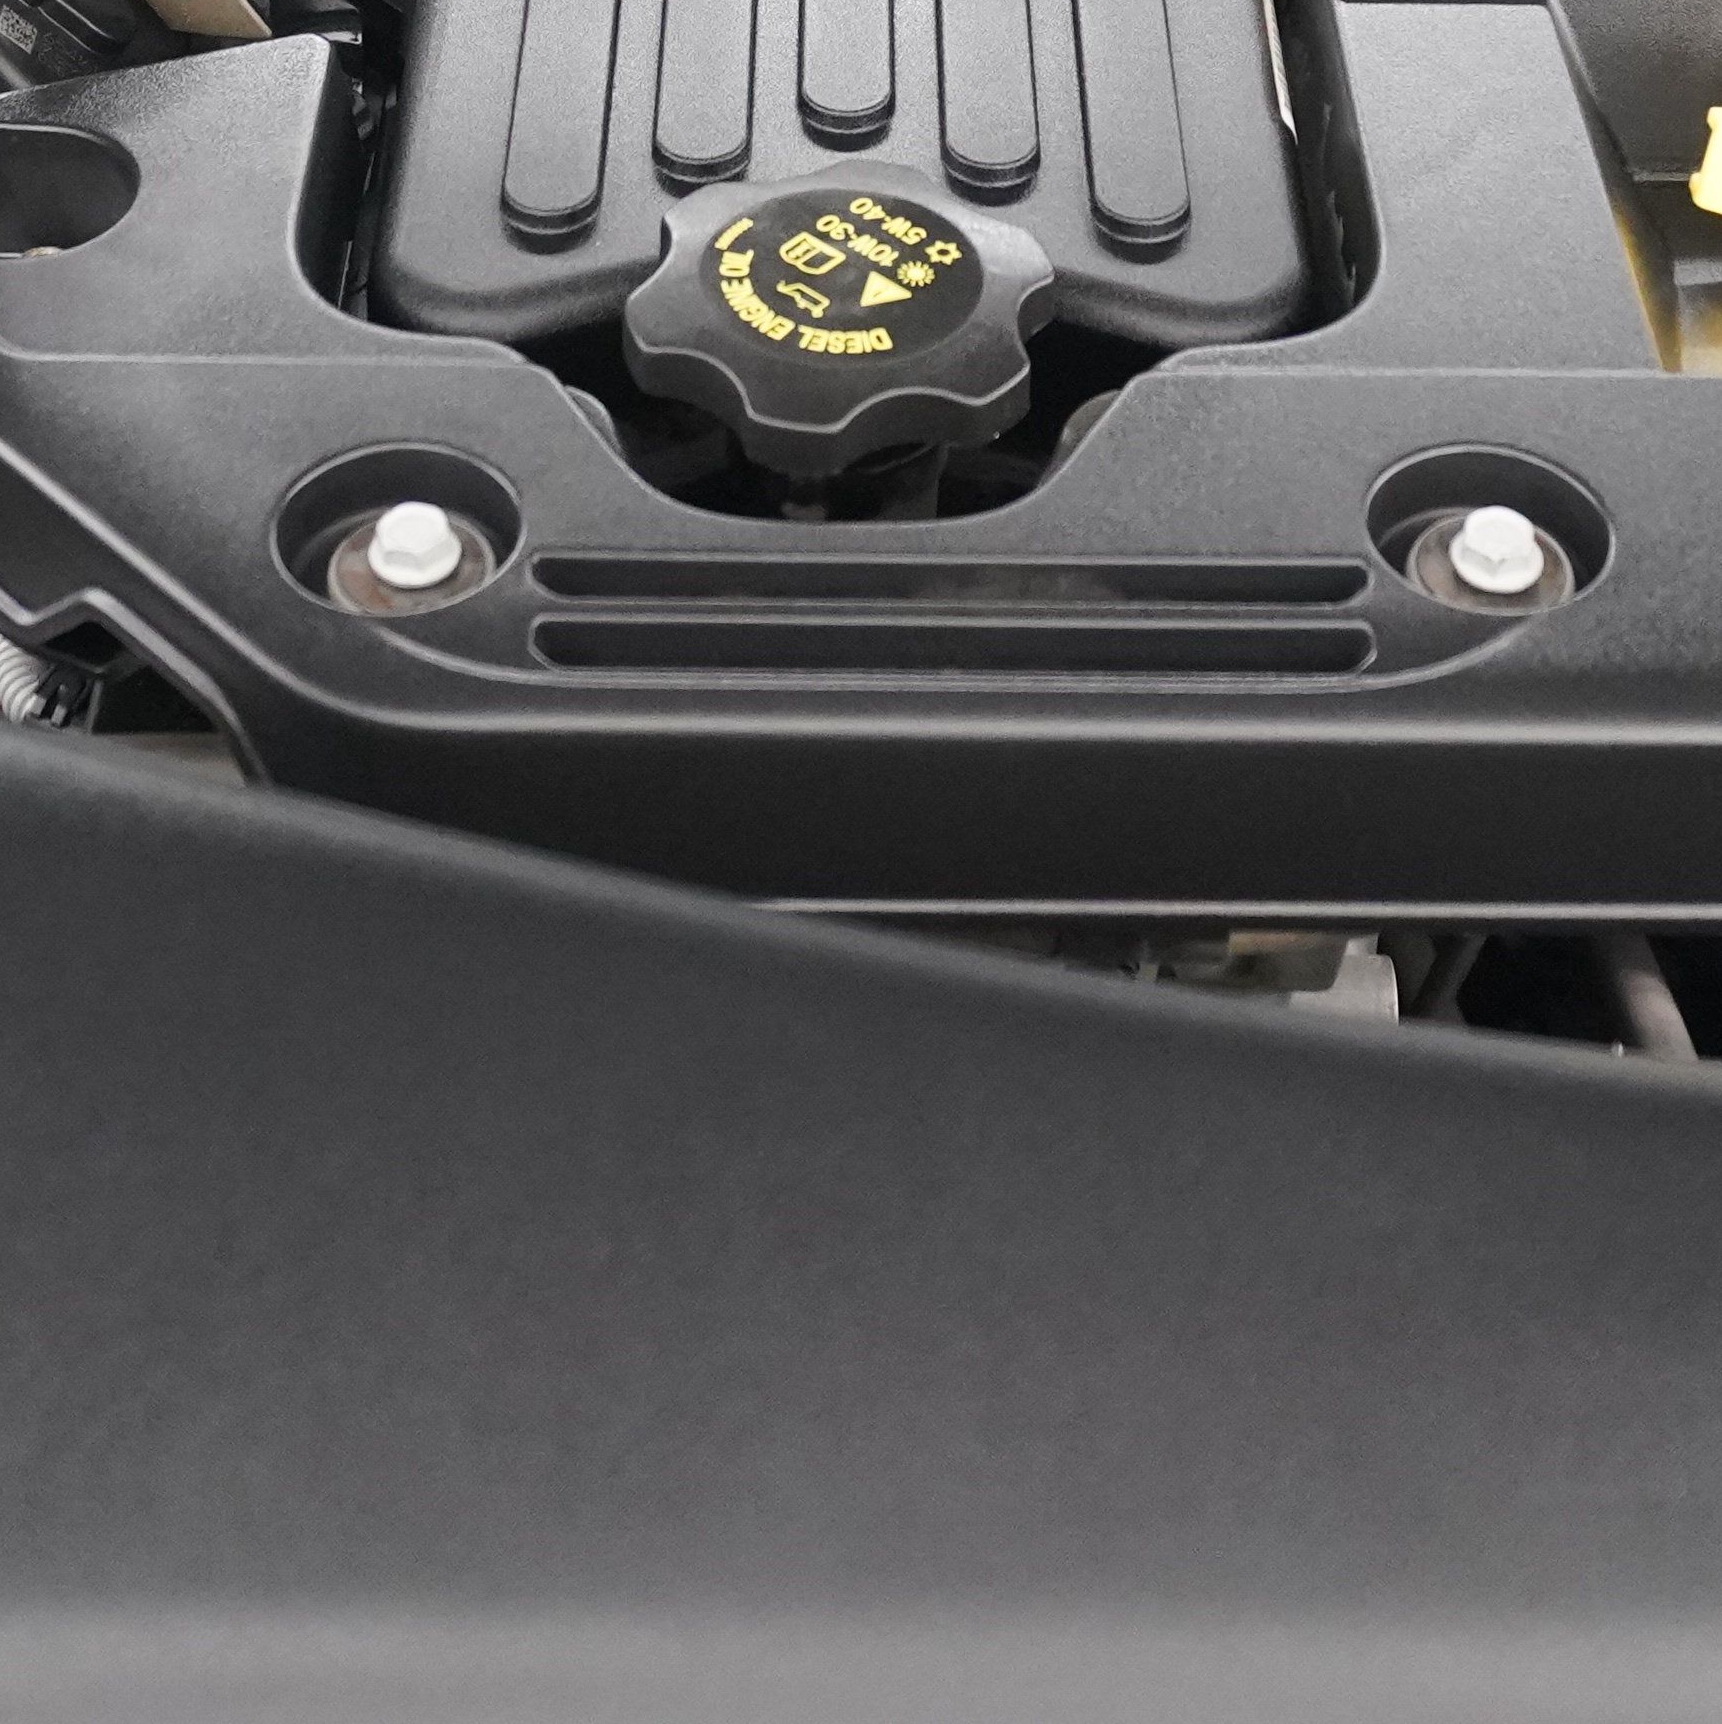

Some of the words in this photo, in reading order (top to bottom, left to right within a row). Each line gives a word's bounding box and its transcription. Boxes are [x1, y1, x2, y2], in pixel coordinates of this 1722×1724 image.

[815, 214, 900, 267] 10W-30
[849, 196, 928, 246] 5W-40
[718, 248, 755, 278] OIL
[719, 276, 797, 342] ENGINE
[798, 324, 894, 355] DIESEL
